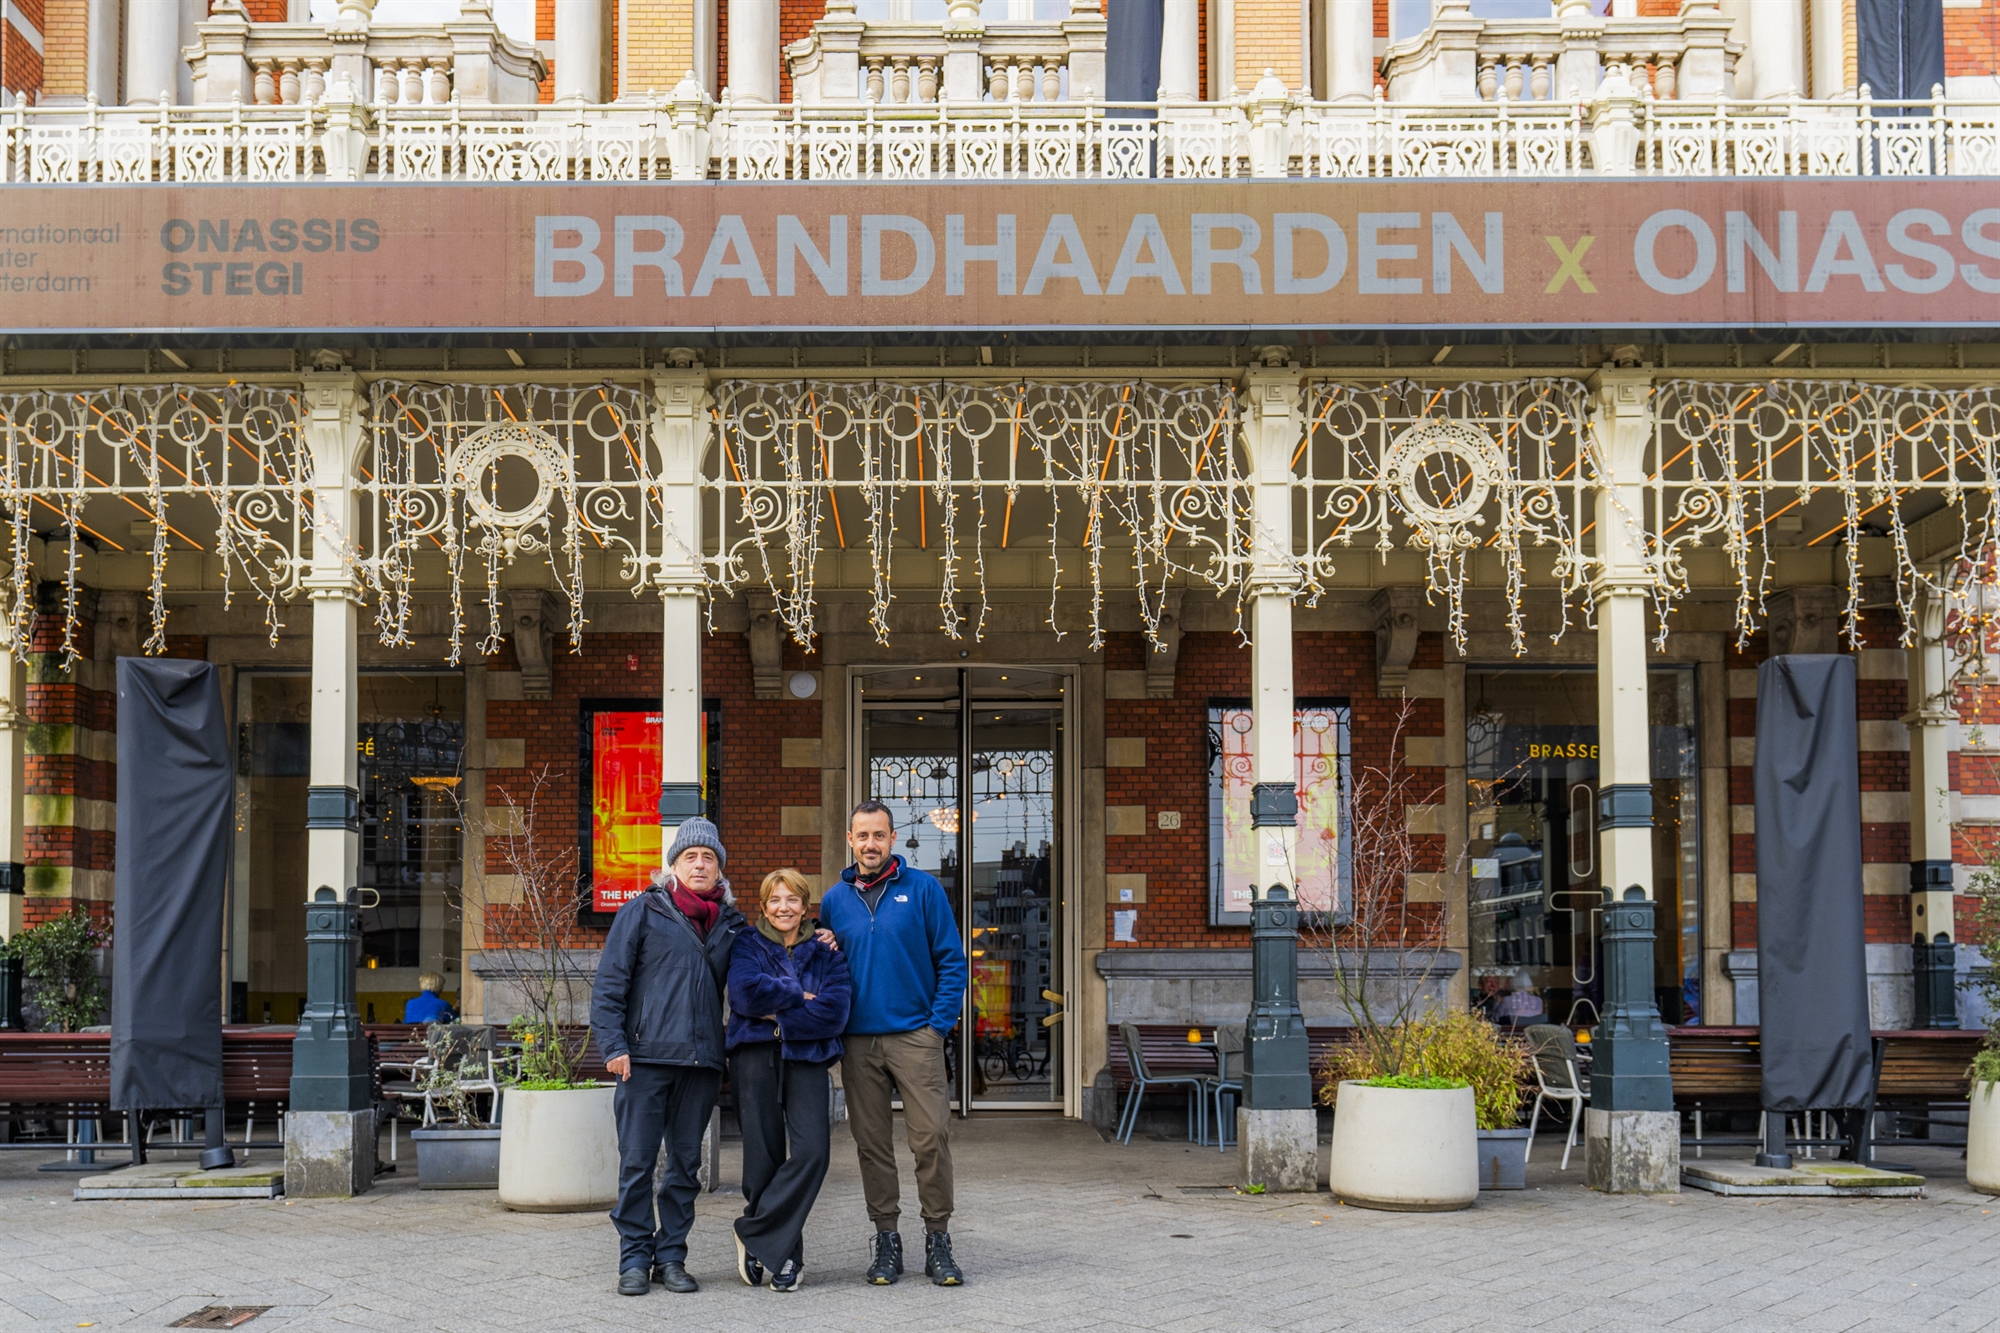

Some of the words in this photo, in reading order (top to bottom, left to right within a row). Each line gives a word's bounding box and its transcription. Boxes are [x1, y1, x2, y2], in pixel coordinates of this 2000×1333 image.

[159, 218, 380, 254] ONASSIS
[533, 212, 1505, 297] BRANDHAARDEN
[1544, 236, 1598, 294] x
[0, 271, 91, 292] terdam
[160, 261, 303, 296] STEGI
[1529, 743, 1599, 759] BRASSE
[1160, 814, 1180, 827] 26
[600, 890, 622, 900] THE
[623, 890, 646, 900] HO
